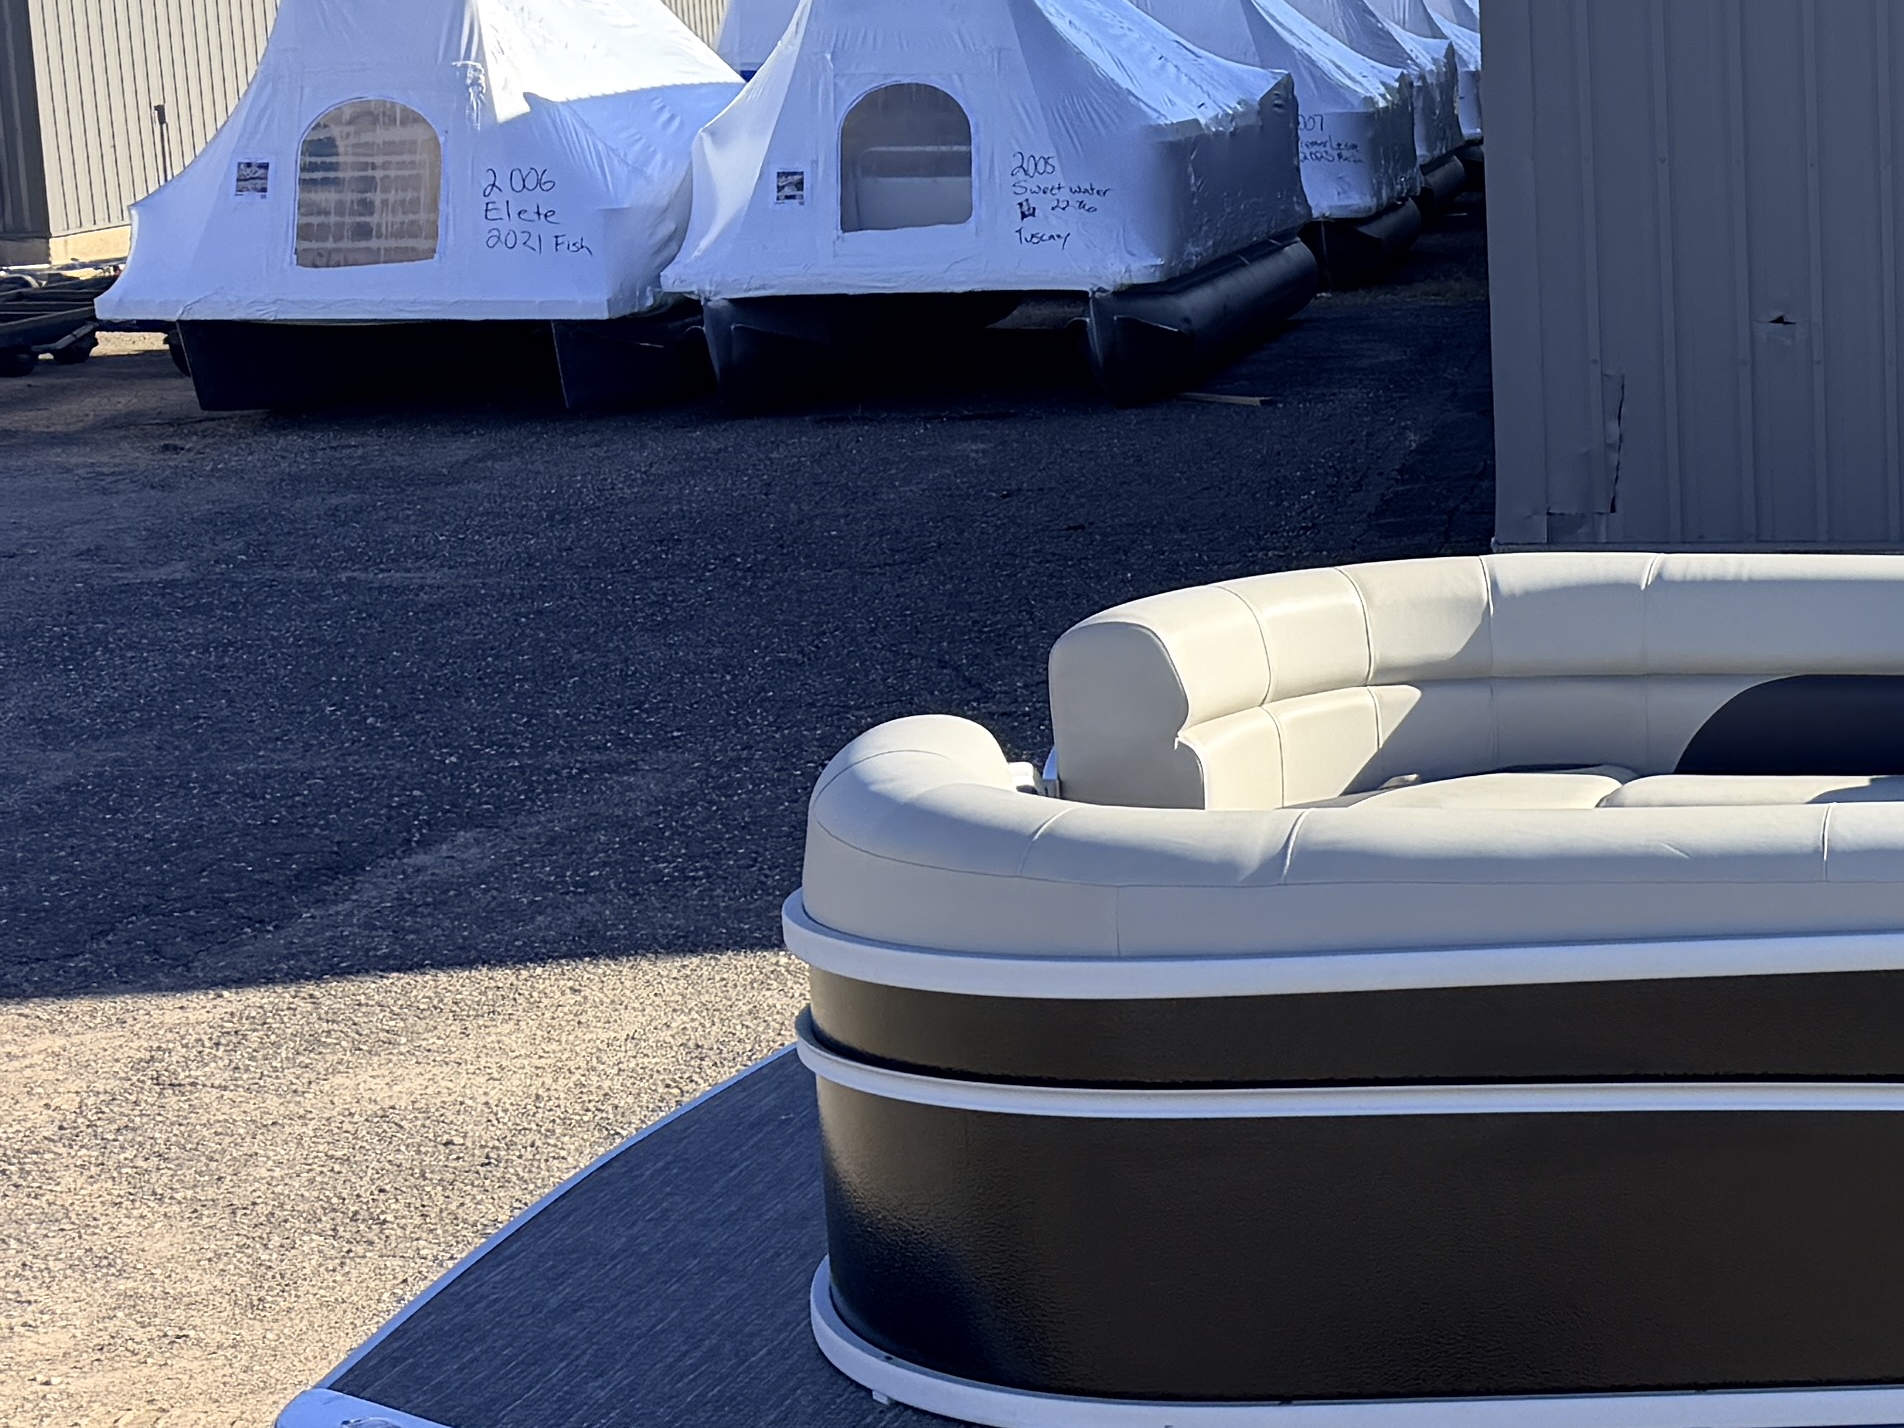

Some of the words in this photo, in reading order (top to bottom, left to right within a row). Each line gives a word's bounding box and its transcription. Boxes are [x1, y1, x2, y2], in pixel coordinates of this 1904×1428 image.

[1011, 151, 1056, 178] 2005
[483, 167, 556, 198] 2006
[486, 228, 542, 254] 2021
[554, 234, 593, 257] Fish
